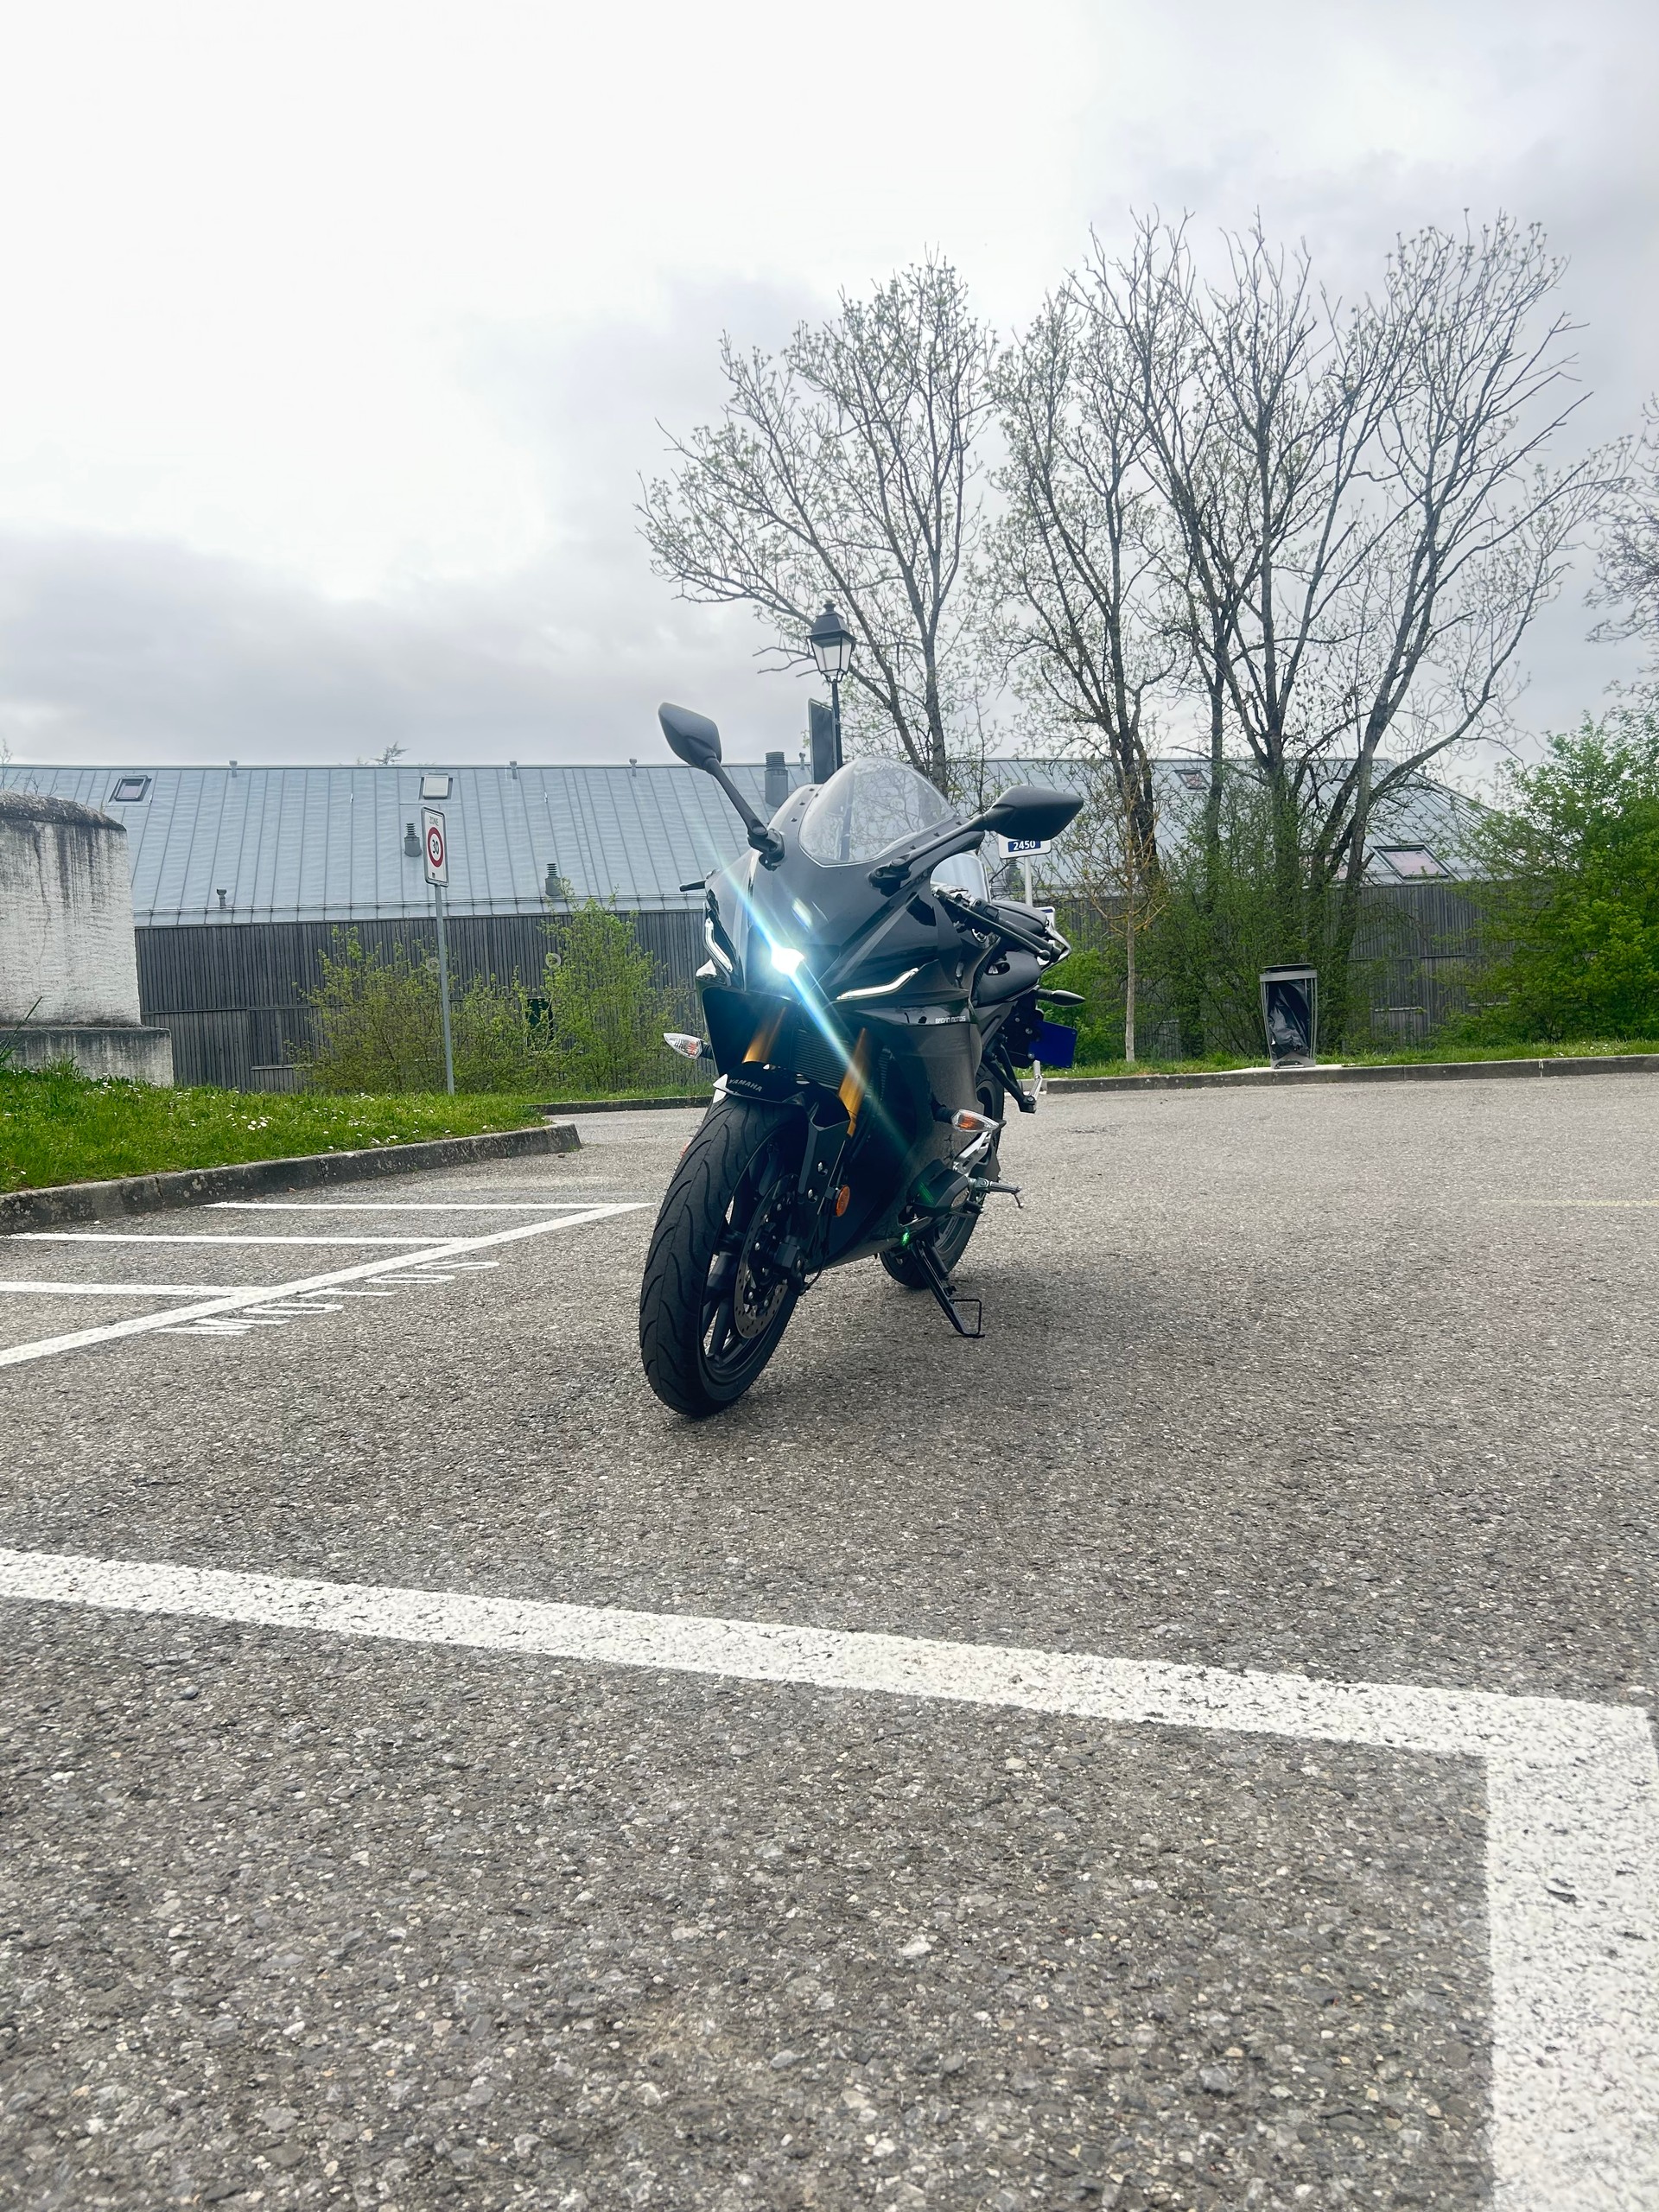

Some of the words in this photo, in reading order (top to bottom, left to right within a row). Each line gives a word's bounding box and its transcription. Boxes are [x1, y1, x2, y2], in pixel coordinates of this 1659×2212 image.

[432, 839, 440, 855] 30
[1013, 840, 1036, 851] 2450
[728, 1079, 763, 1092] YAMAHA
[149, 1261, 500, 1335] MOTOS
